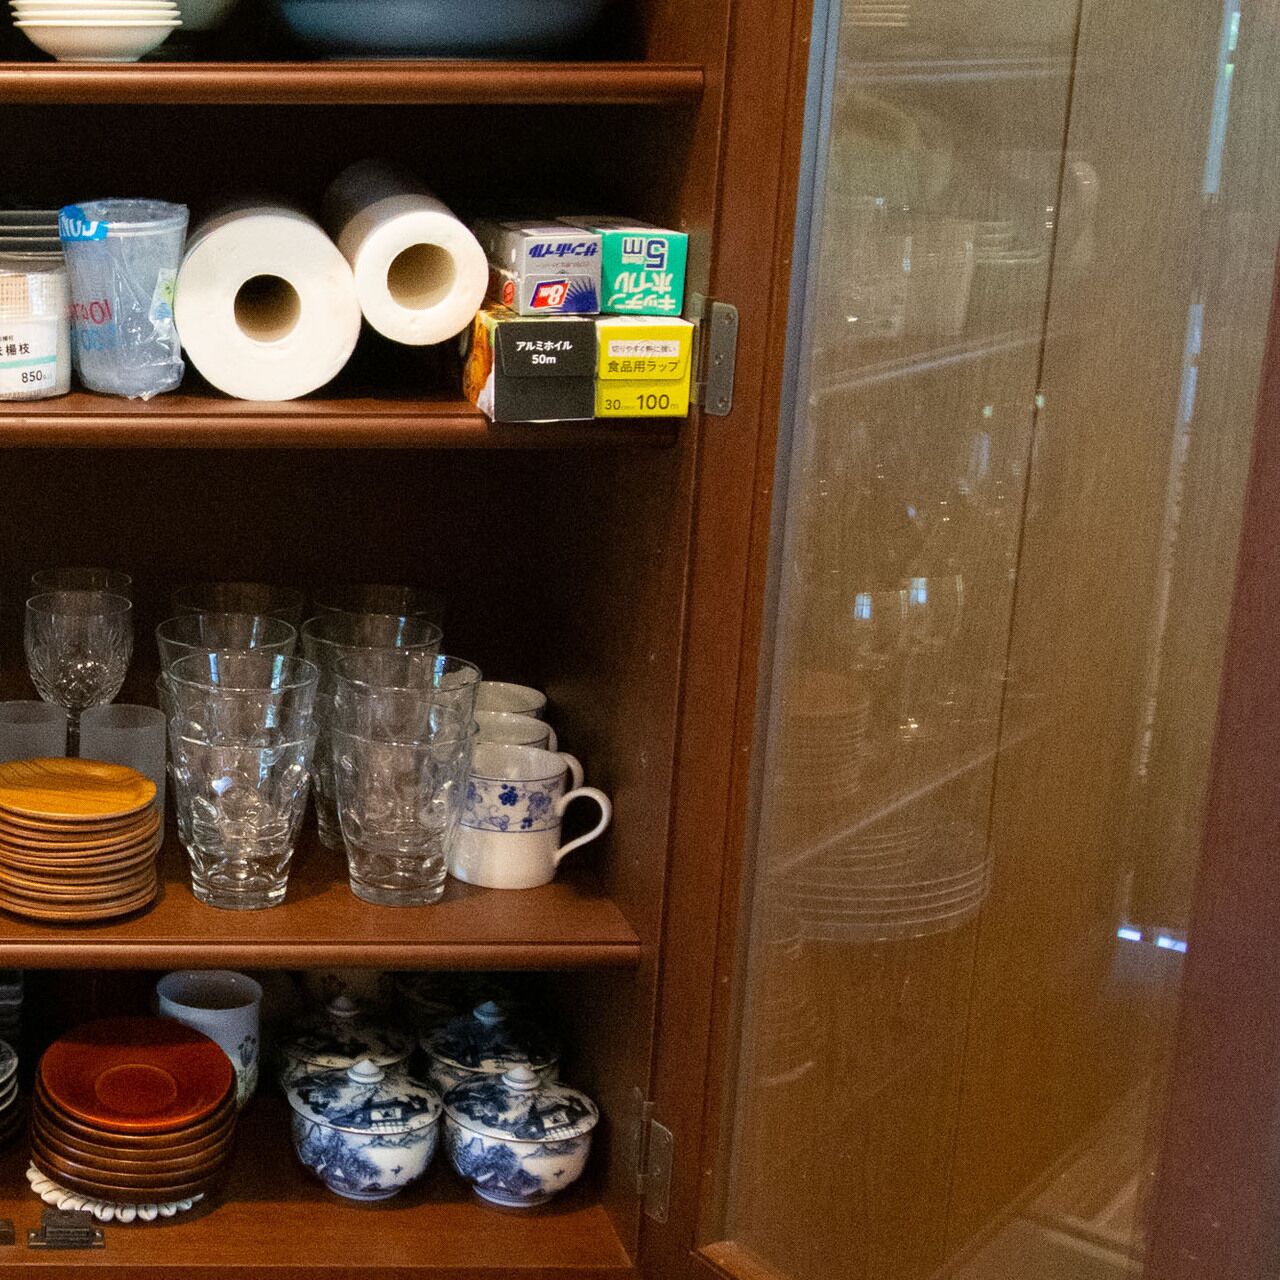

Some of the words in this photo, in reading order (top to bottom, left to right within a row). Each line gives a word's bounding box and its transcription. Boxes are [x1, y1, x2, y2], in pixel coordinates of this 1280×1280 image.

[528, 241, 599, 259] サンホイル
[614, 271, 674, 295] ホイル
[607, 294, 677, 311] キッチン
[515, 340, 574, 352] アルミホイル
[531, 354, 557, 365] 50m
[607, 360, 680, 374] 食品用ラップ
